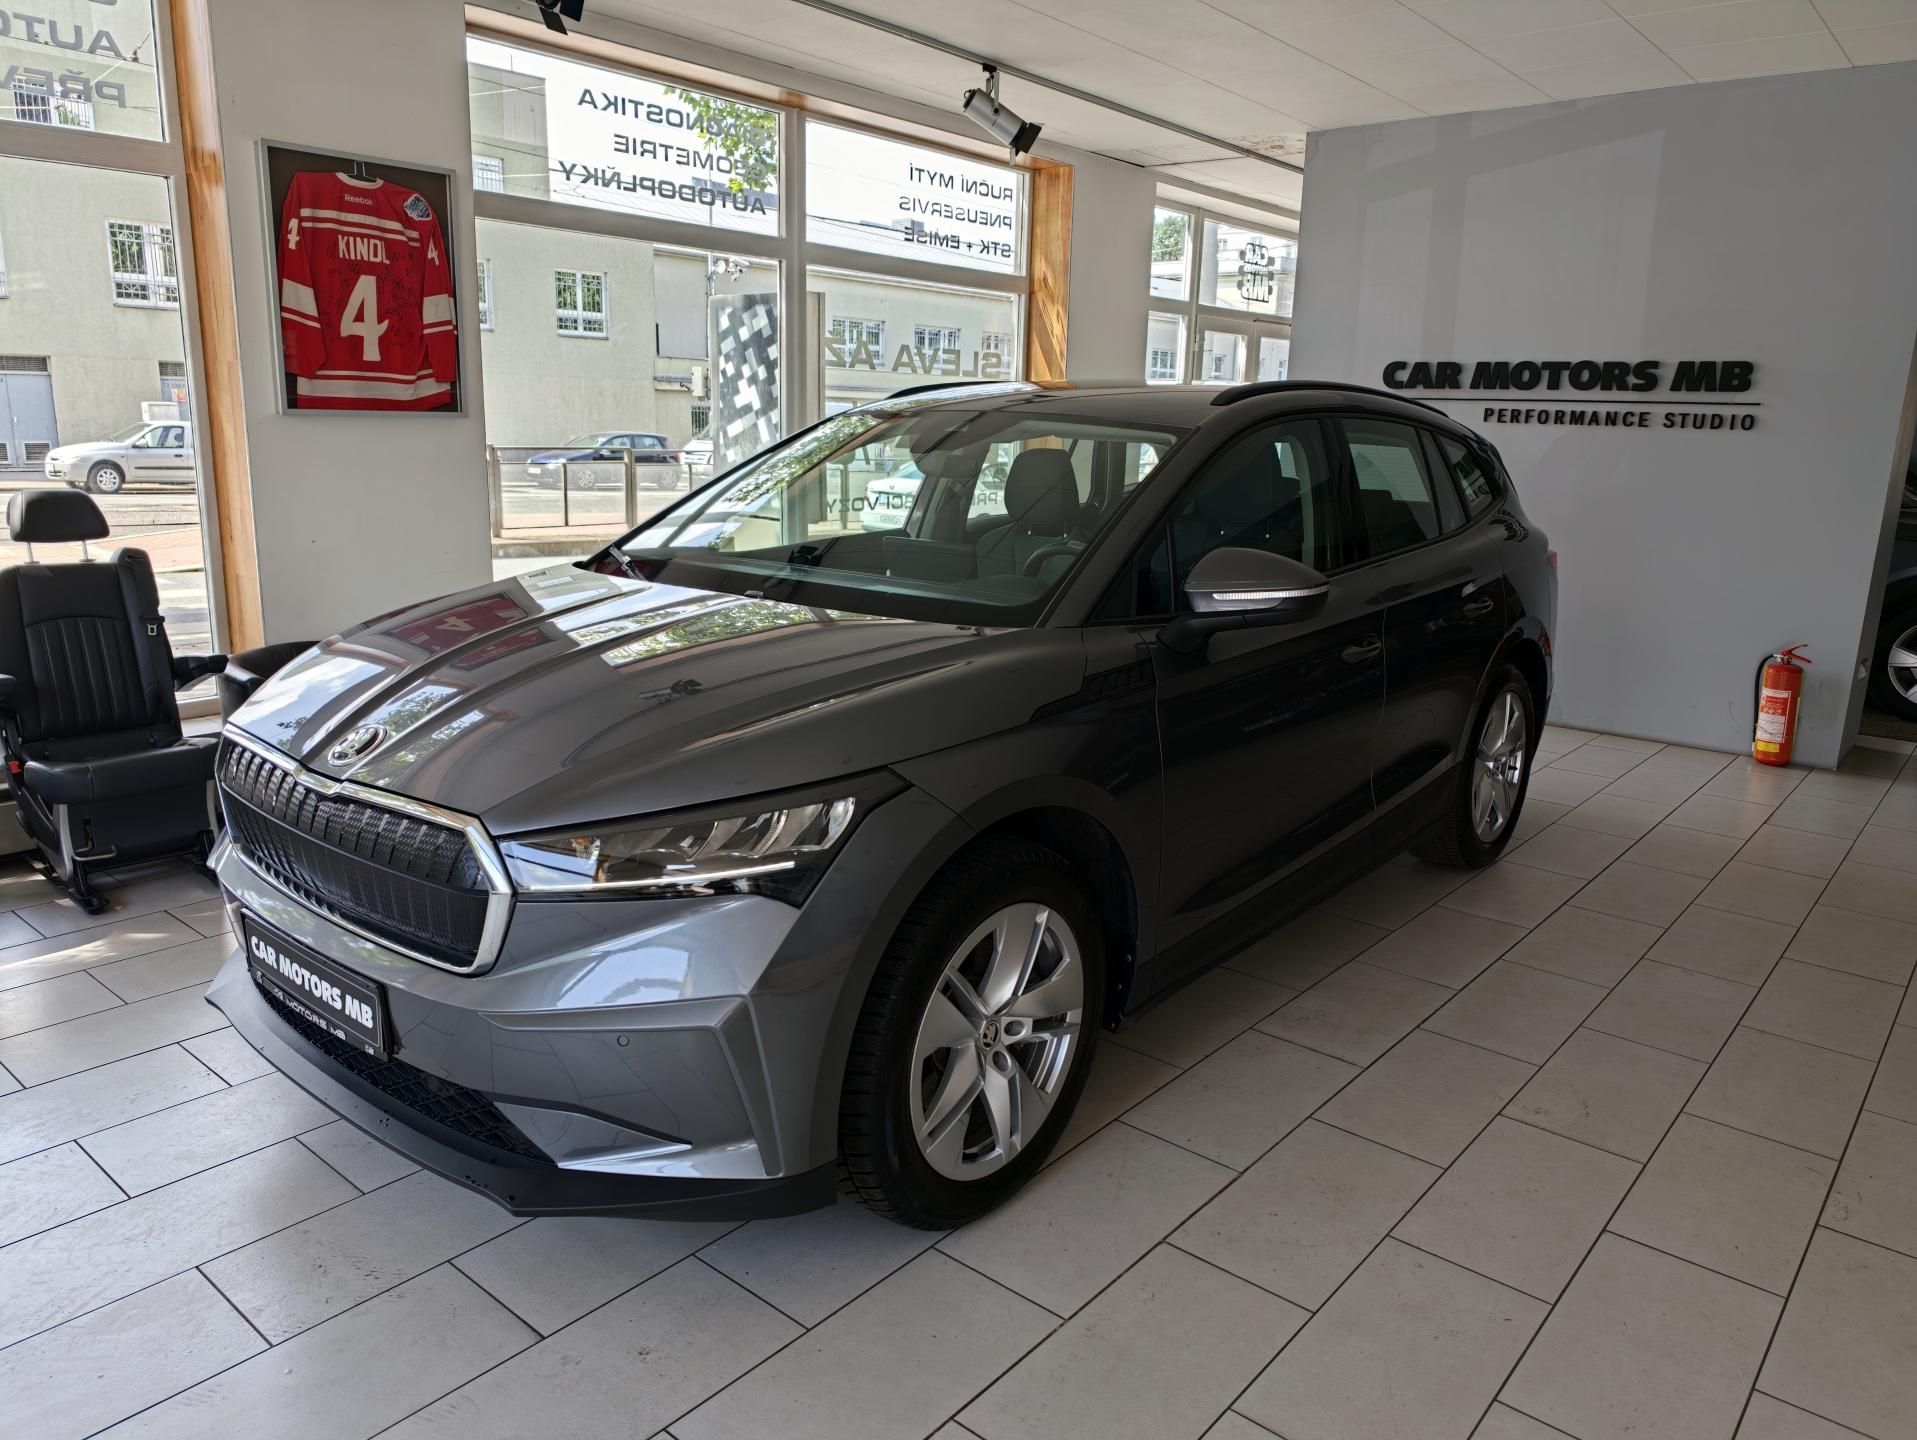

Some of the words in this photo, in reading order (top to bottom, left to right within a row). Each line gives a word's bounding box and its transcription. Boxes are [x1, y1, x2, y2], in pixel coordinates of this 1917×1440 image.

[344, 193, 373, 206] Reebok
[287, 218, 300, 250] 4
[338, 234, 391, 265] KINDL
[427, 237, 440, 266] 4
[340, 274, 389, 362] 4
[1382, 361, 1462, 390] CAR
[1470, 360, 1660, 392] MOTORS
[1669, 360, 1755, 393] MB
[1483, 407, 1650, 428] PERFORMANCE
[1663, 412, 1756, 431] STUDIO
[251, 935, 278, 970] CAR
[279, 953, 343, 1011] MOTORS
[345, 994, 374, 1029] MB
[286, 998, 327, 1030] MOTORS
